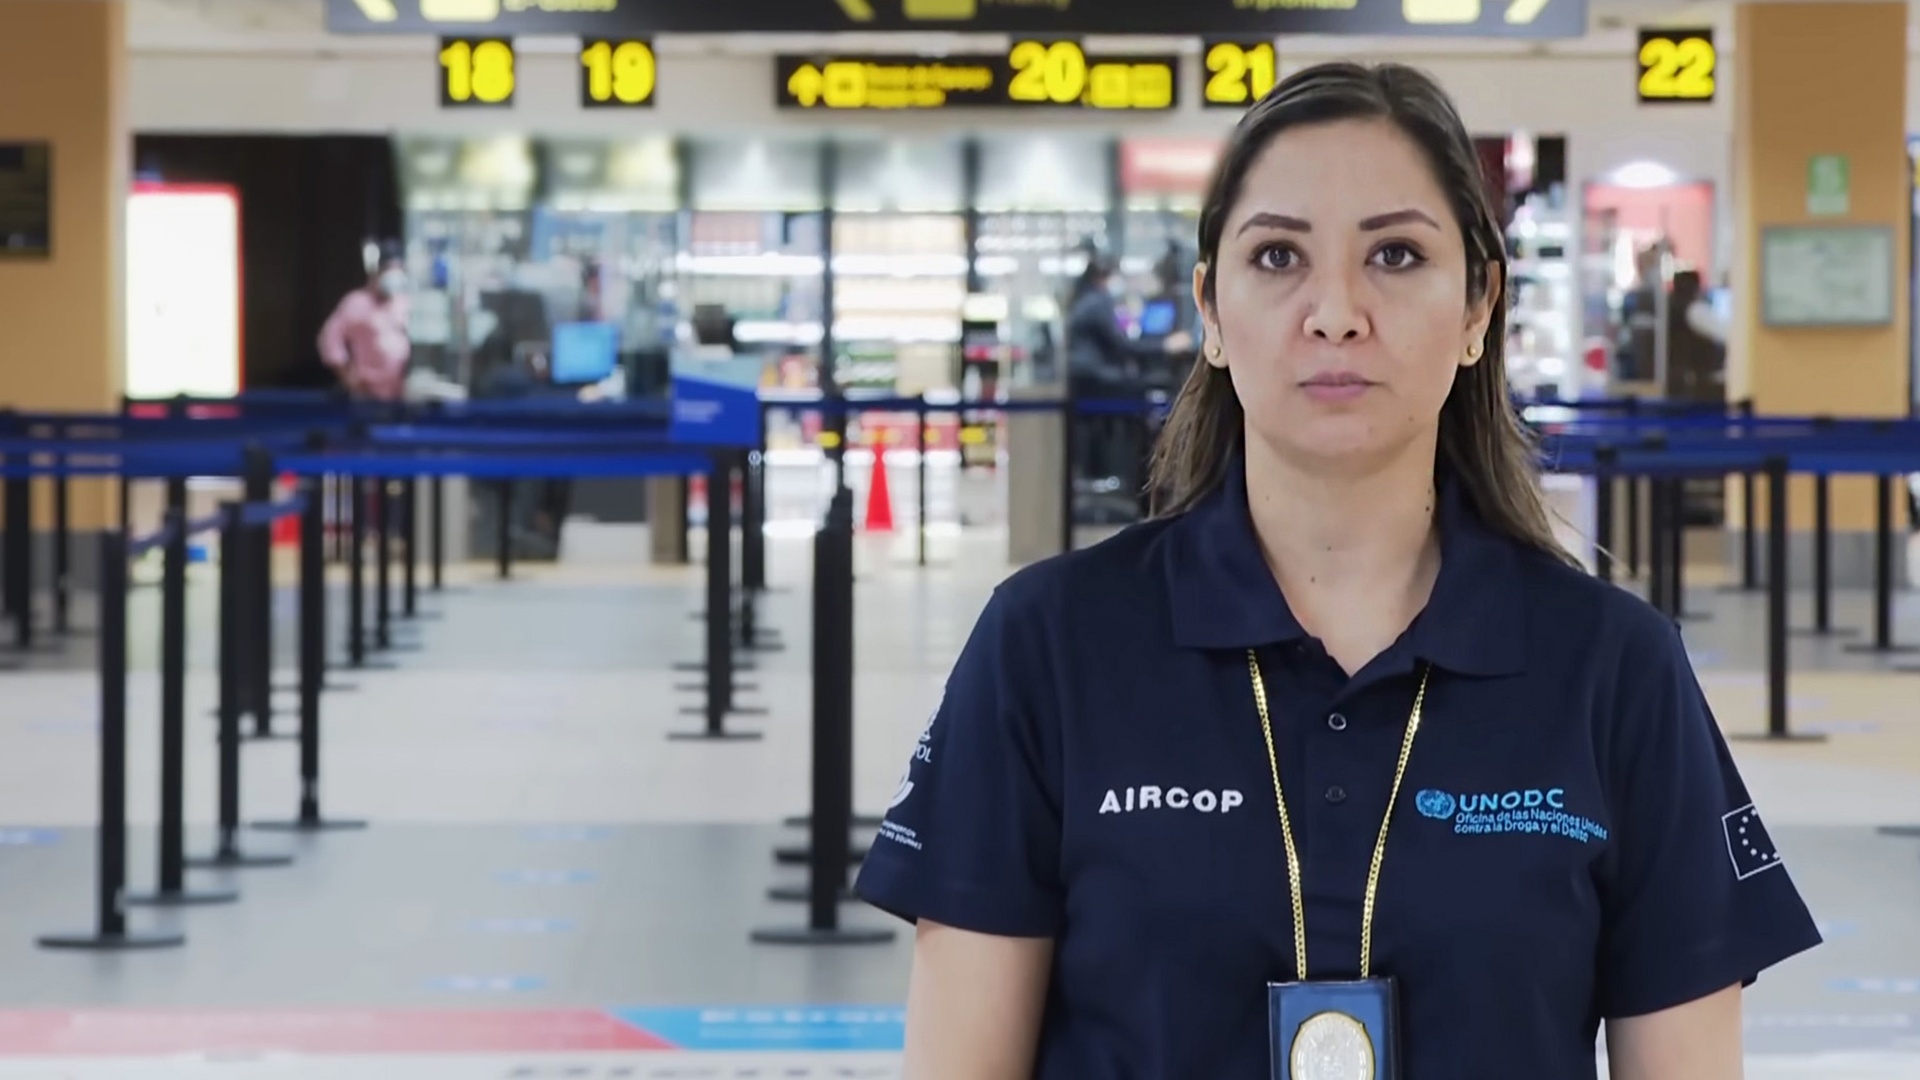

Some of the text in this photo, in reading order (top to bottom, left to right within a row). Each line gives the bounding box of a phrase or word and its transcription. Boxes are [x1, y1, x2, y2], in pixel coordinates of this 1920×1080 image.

[439, 41, 515, 102] 18
[581, 41, 656, 102] 19
[1008, 40, 1086, 103] 20
[1205, 43, 1276, 102] 21
[1637, 37, 1716, 98] 22
[1099, 785, 1244, 814] AIRCOP
[1454, 821, 1491, 833] contra
[1504, 819, 1540, 833] Droga
[1541, 821, 1549, 834] y
[1456, 808, 1608, 840] Oficina de las Naciones Unidas
[1459, 788, 1564, 812] UNODC
